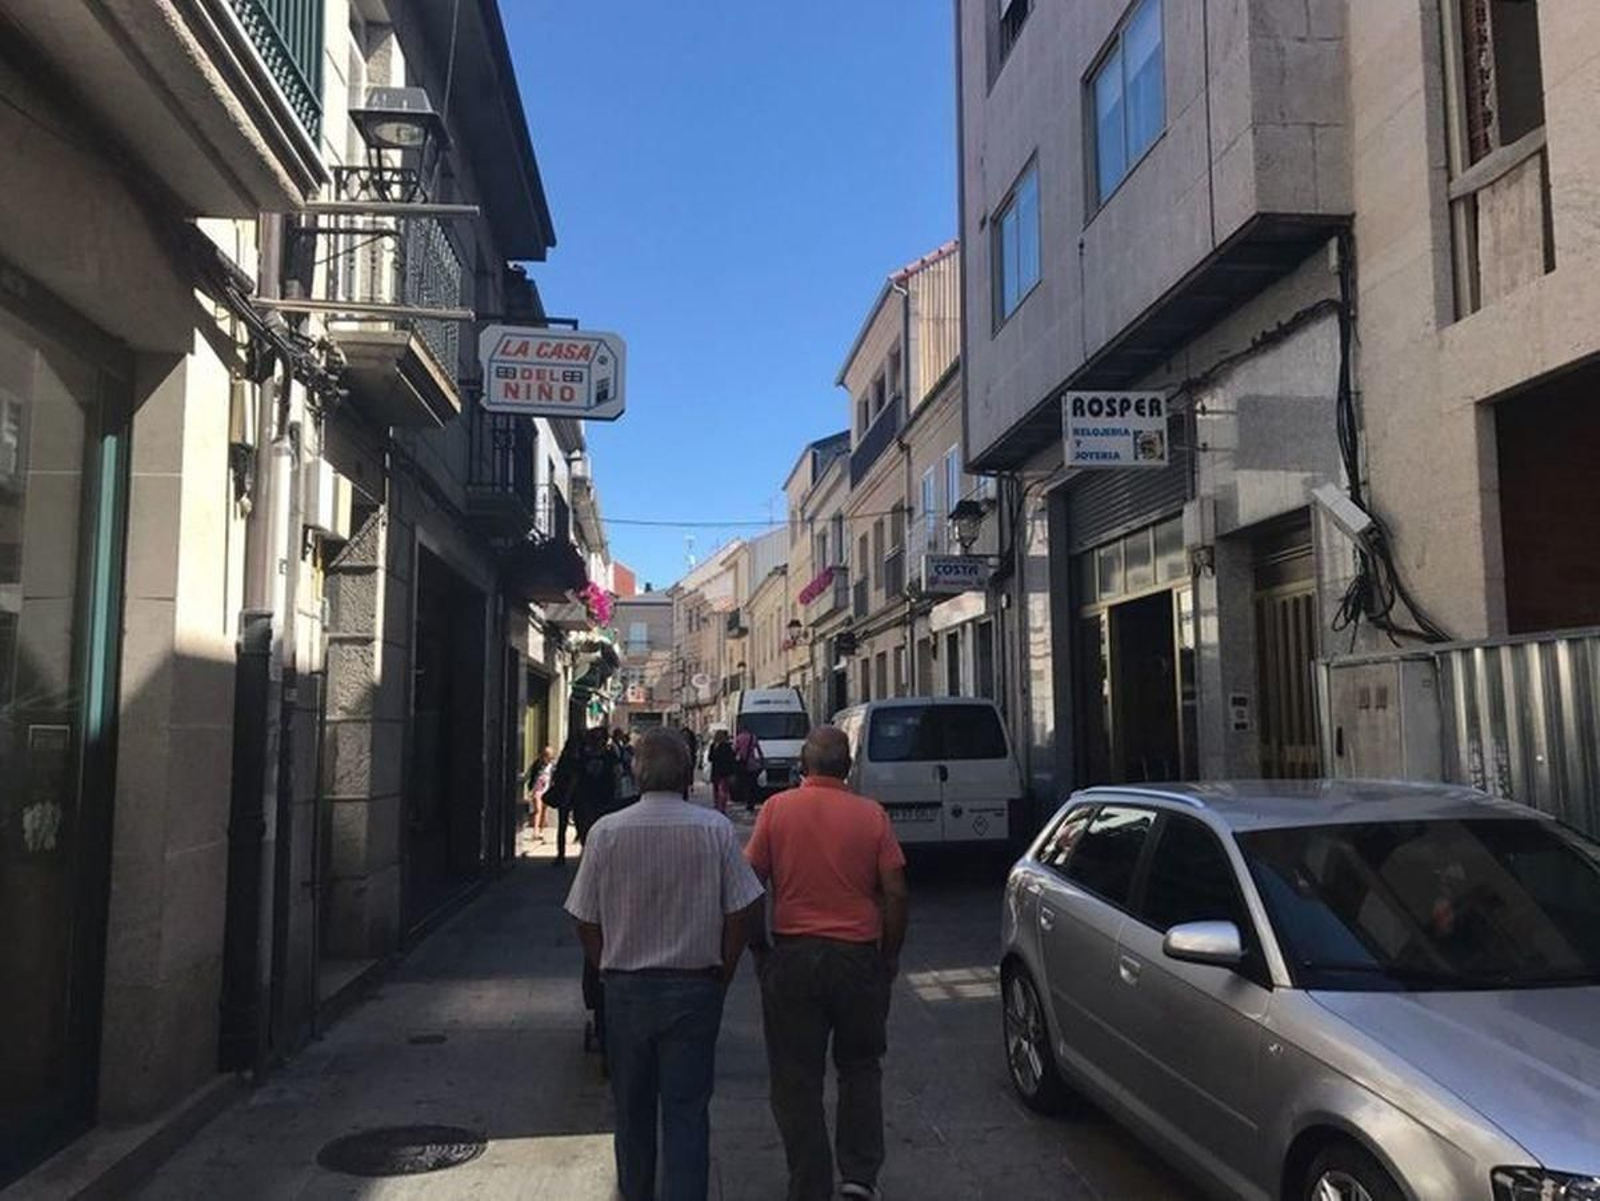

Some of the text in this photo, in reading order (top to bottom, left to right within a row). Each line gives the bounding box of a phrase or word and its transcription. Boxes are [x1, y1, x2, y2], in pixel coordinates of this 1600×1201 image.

[501, 339, 592, 361] LA CASA
[521, 368, 559, 382] DEL
[503, 382, 576, 402] NIÑO
[1073, 397, 1162, 417] ROSPER
